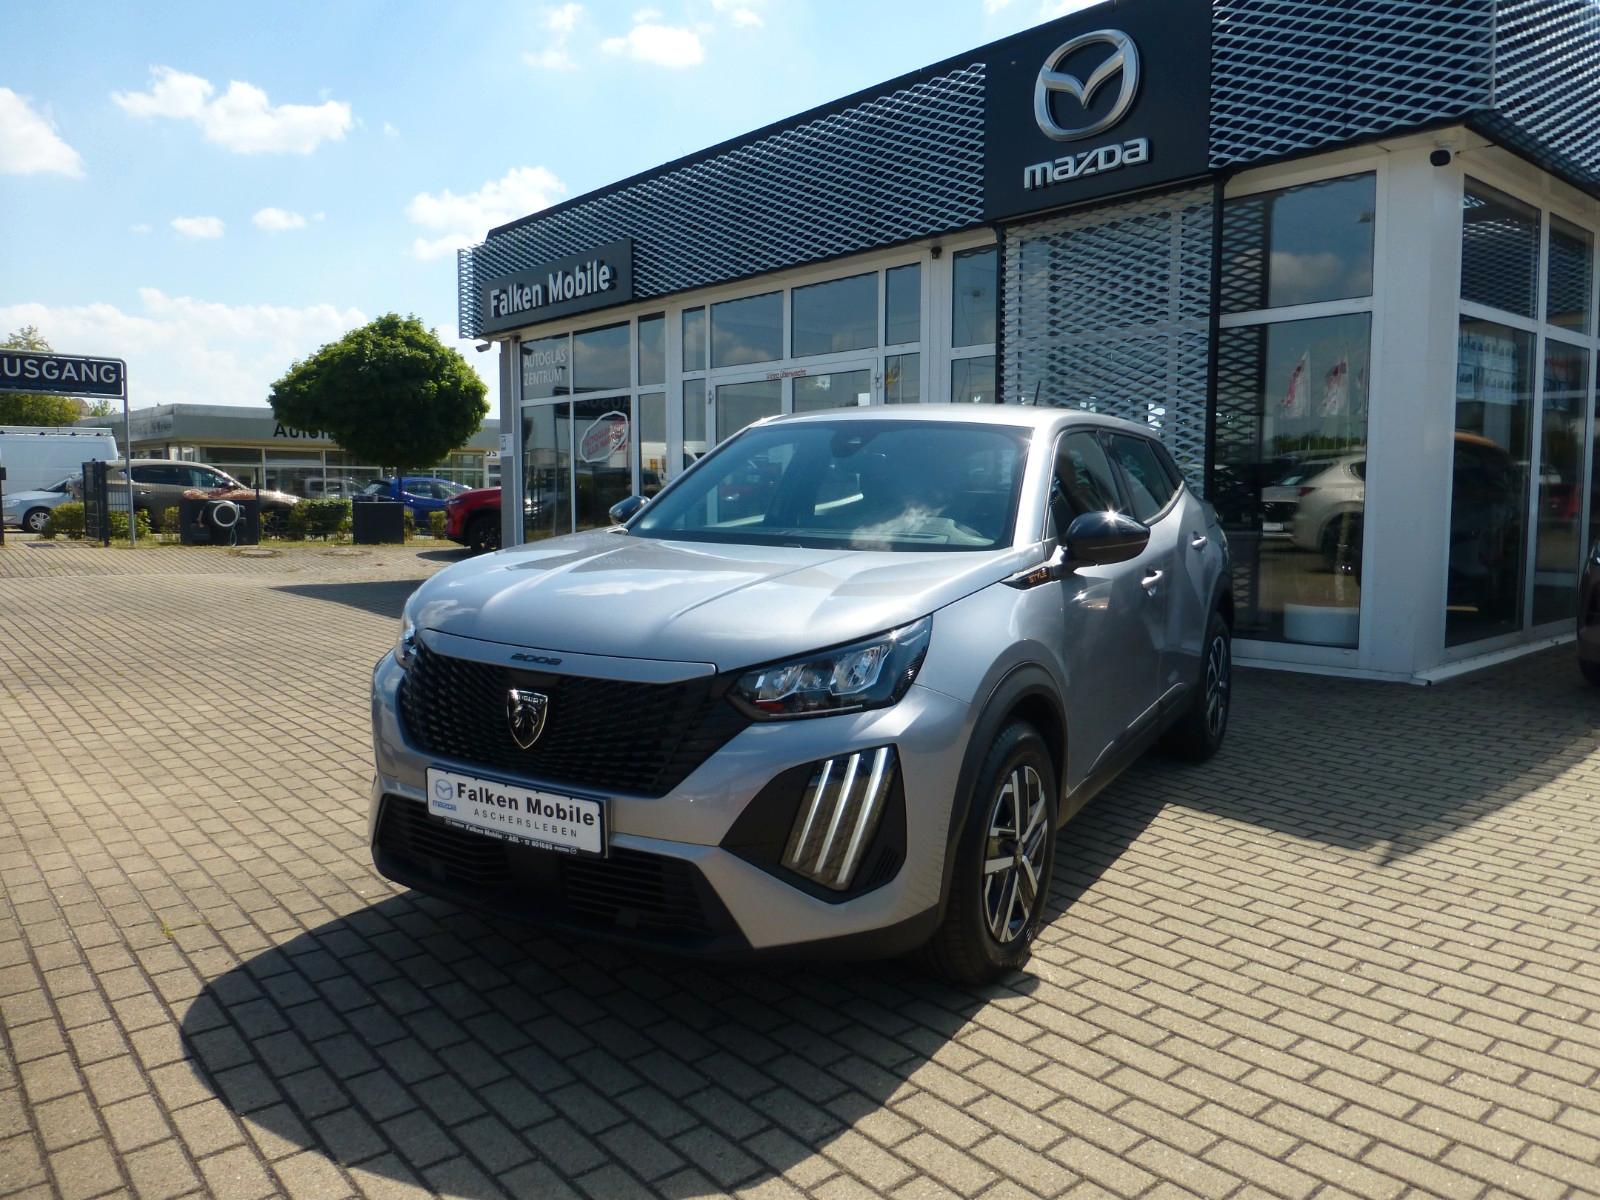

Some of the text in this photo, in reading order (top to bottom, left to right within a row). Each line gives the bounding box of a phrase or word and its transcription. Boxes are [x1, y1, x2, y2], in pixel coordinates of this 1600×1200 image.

[489, 259, 611, 319] Falken Mobile
[0, 357, 117, 384] USGANG
[523, 349, 567, 368] AUTOGLAS
[523, 368, 562, 386] ZENTRUM
[511, 653, 561, 665] 2008
[457, 782, 595, 826] Falken Mobile
[474, 808, 577, 838] ASCHERSLEBEN
